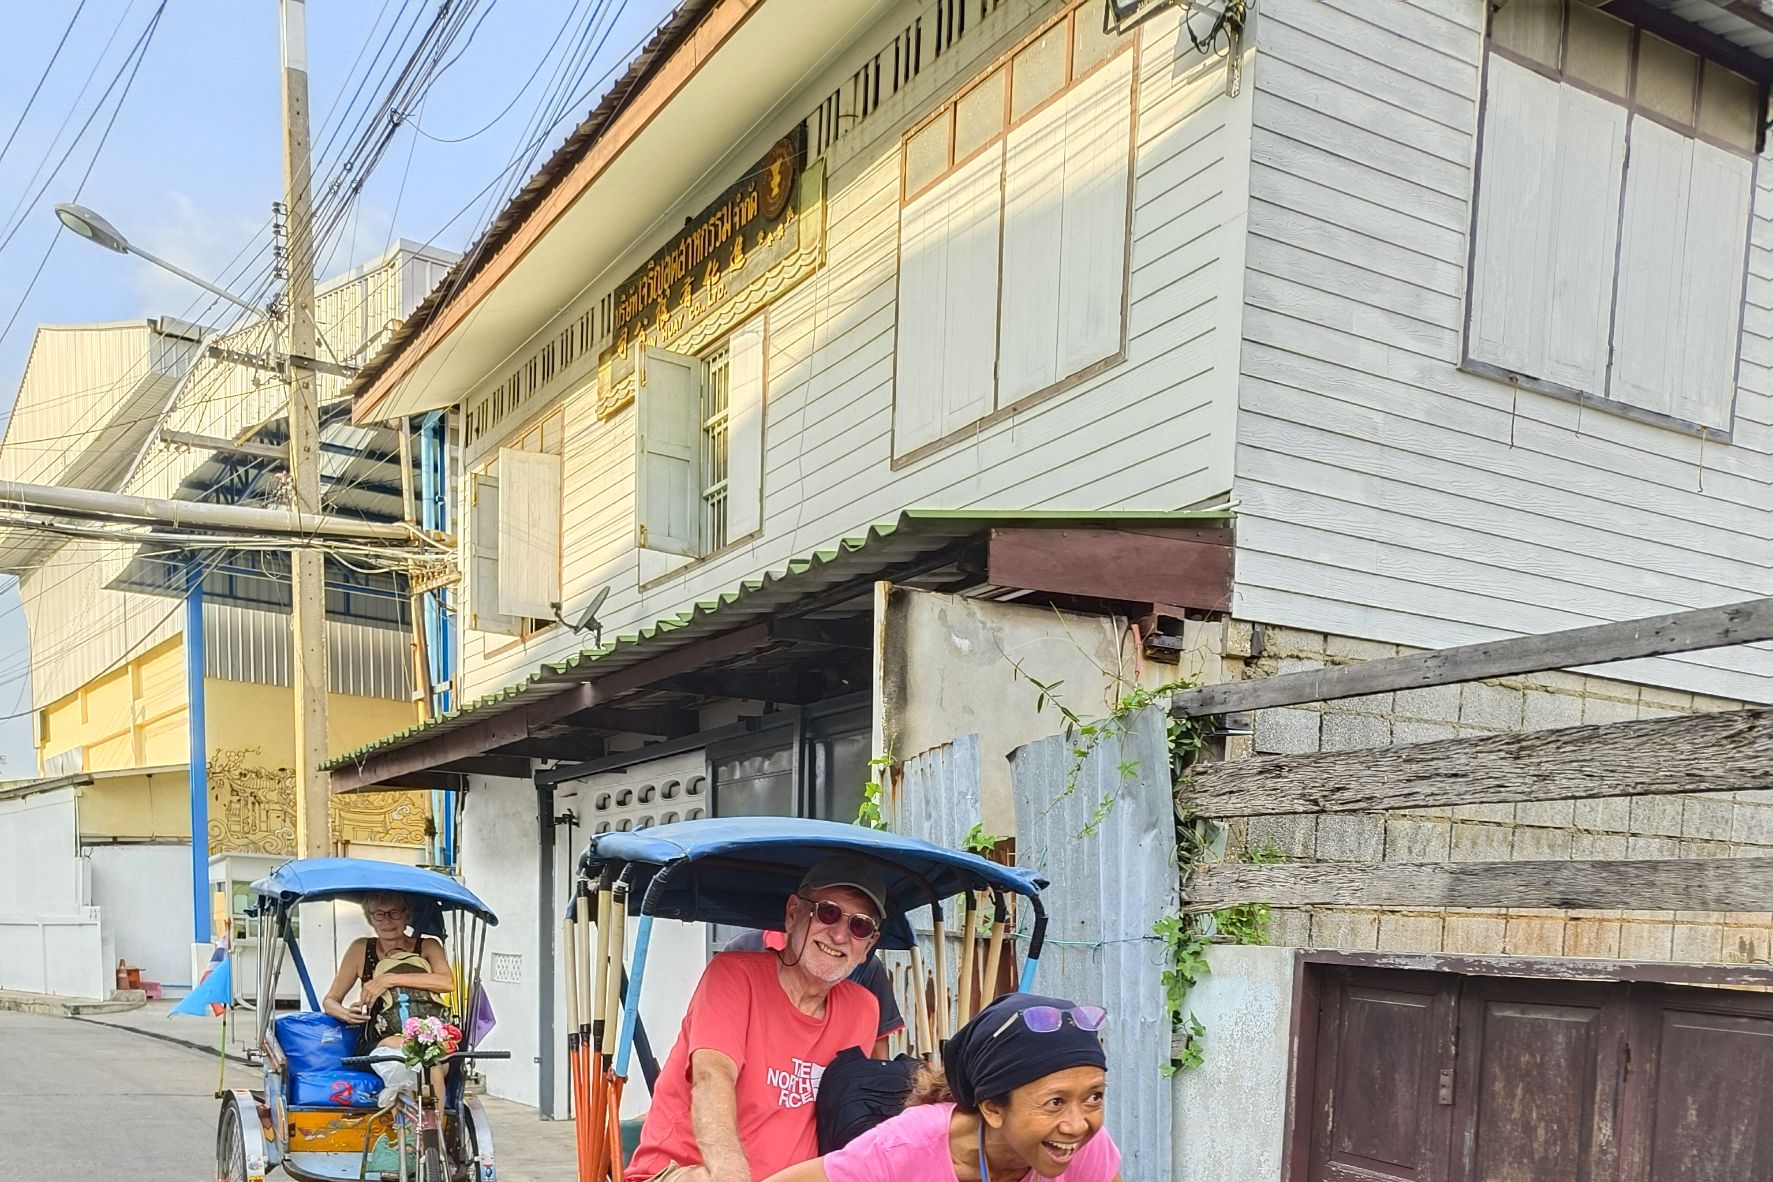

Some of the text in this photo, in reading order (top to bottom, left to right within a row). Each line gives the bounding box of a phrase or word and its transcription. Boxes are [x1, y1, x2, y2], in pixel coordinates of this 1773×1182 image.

[661, 314, 685, 343] HUAY
[791, 1057, 812, 1078] TE
[328, 1079, 353, 1106] 2
